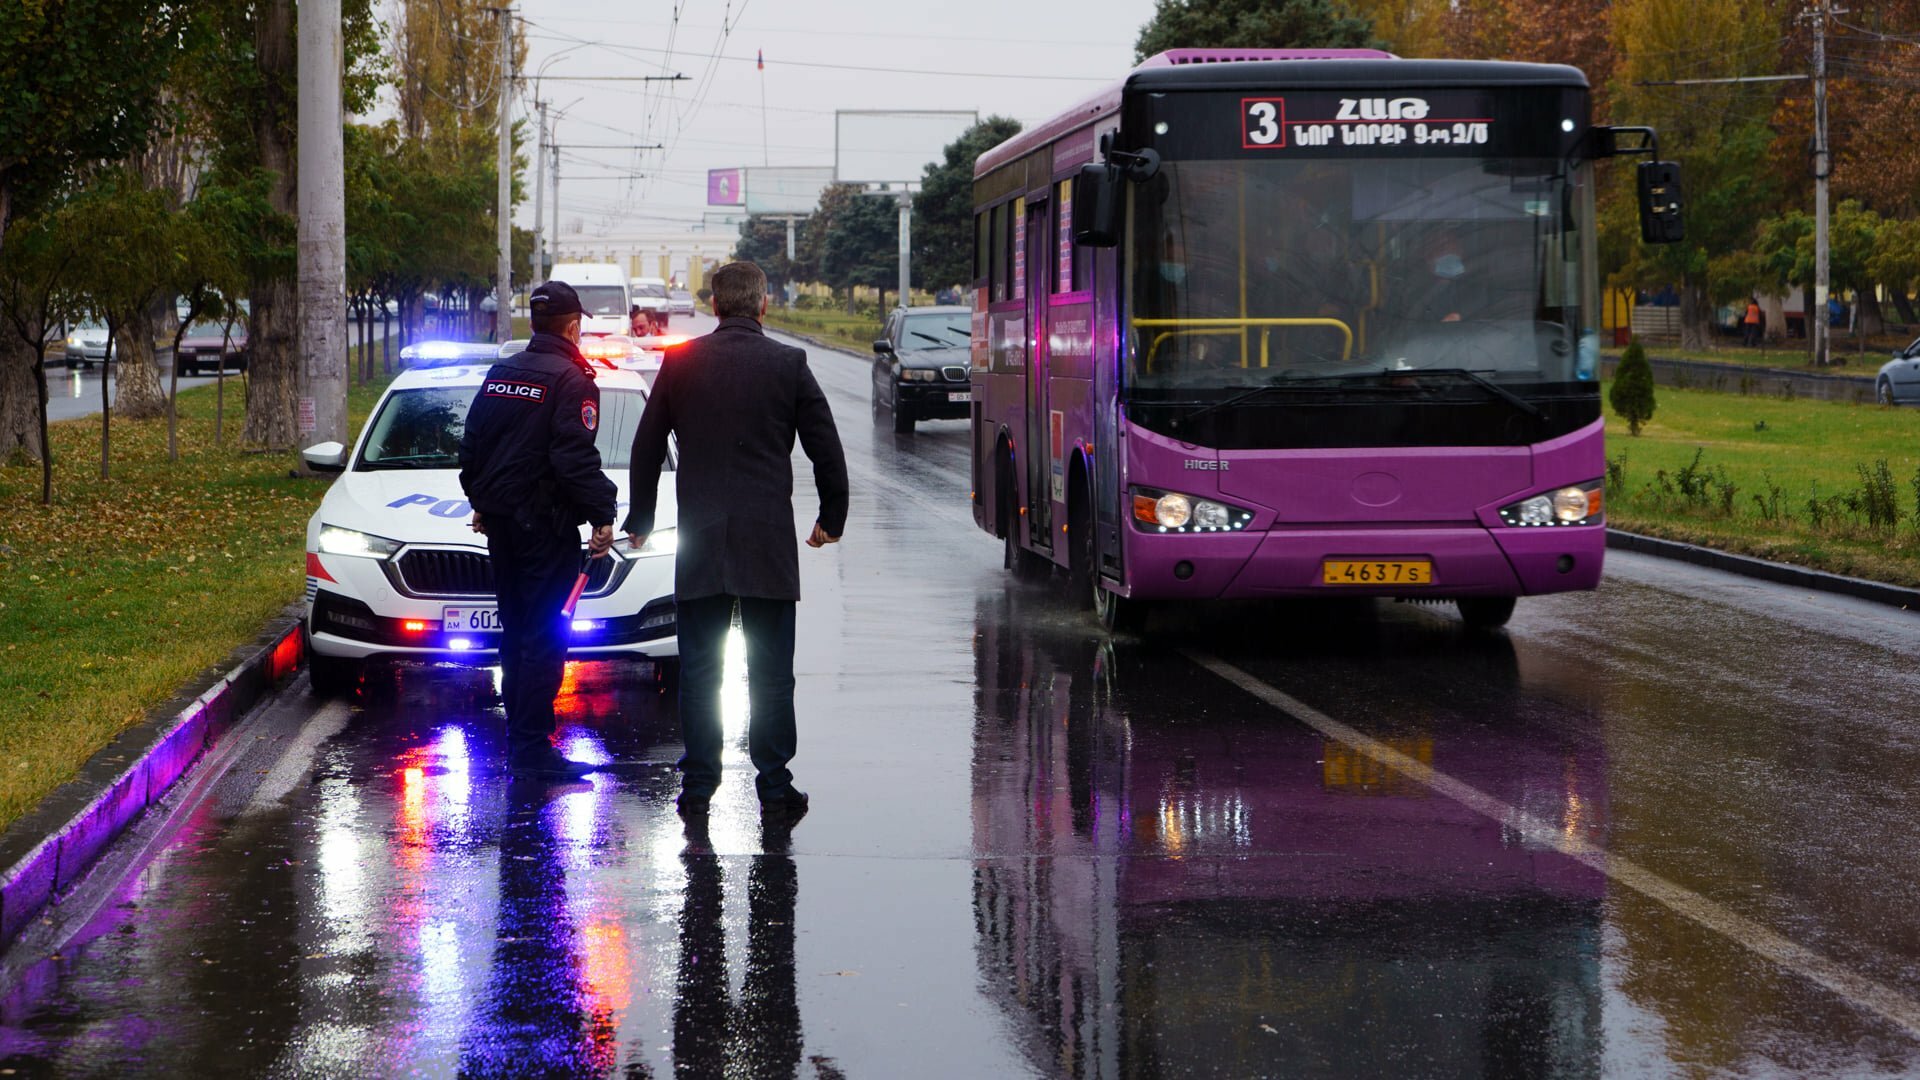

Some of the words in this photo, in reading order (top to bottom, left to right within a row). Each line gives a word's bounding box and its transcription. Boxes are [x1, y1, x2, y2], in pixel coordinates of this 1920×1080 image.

[1335, 97, 1430, 120] ՀԱԹ
[1249, 102, 1278, 144] 3
[1293, 124, 1334, 146] ՆՈՐ
[1340, 123, 1407, 145] ՆՈՐՔԻ
[486, 383, 542, 399] POLICE
[1184, 459, 1230, 471] HIGER
[385, 493, 473, 518] PO
